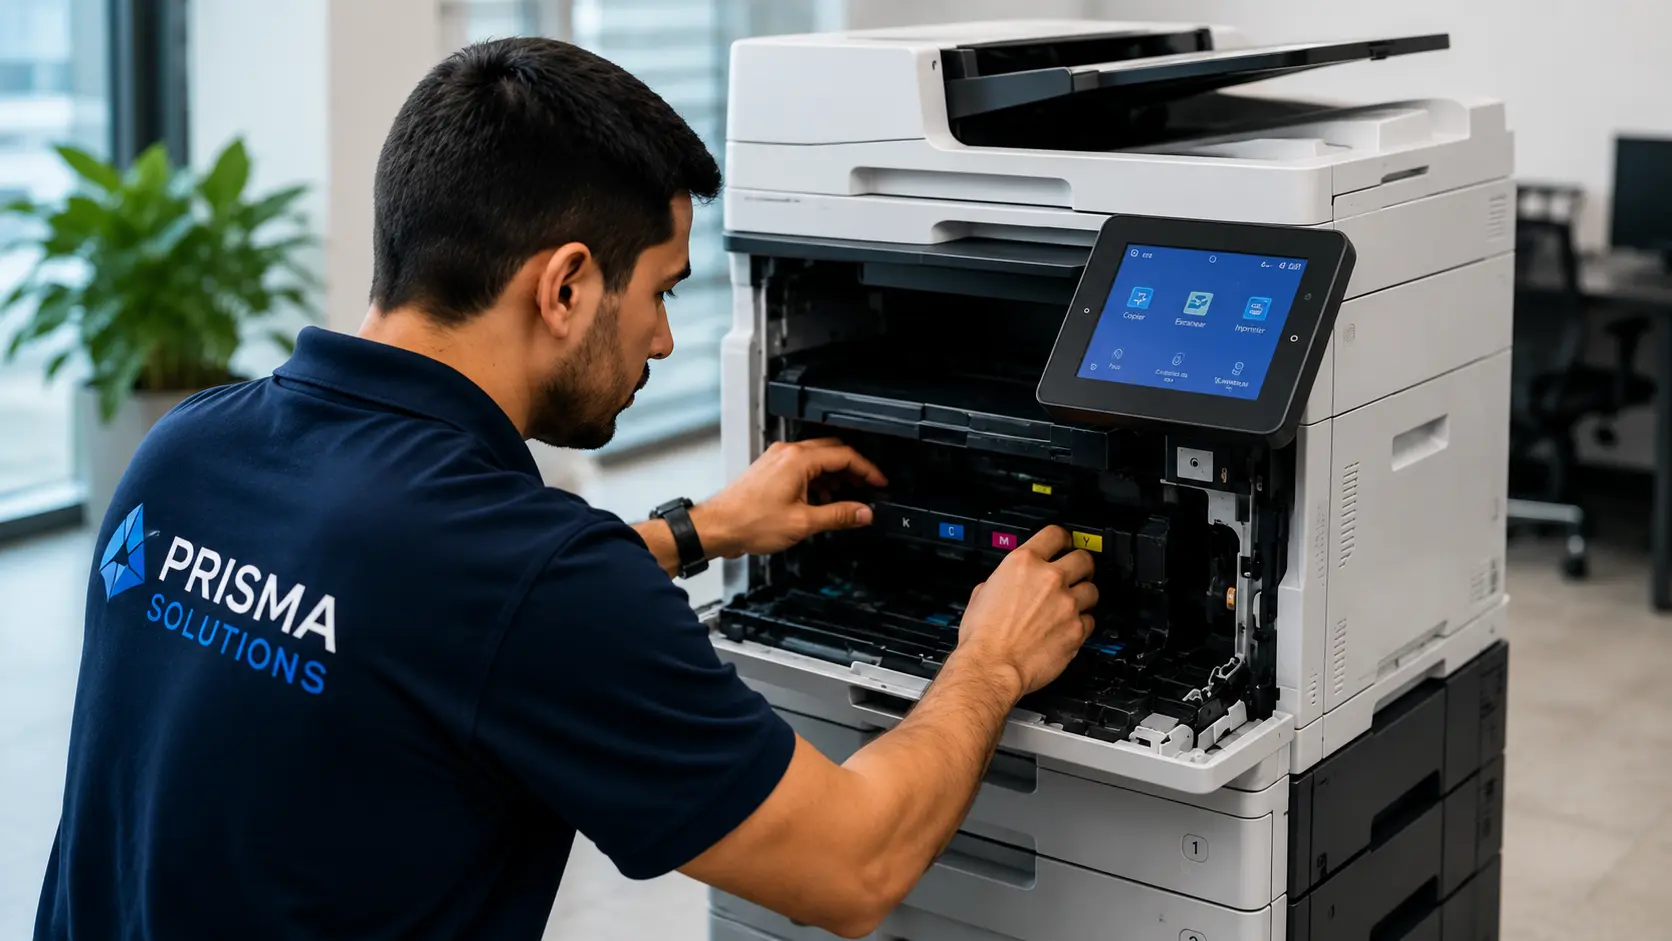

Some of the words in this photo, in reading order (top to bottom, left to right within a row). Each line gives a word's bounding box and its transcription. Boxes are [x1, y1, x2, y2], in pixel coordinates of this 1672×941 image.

[902, 517, 910, 528] K
[948, 526, 955, 536] C
[999, 535, 1010, 547] M
[1082, 535, 1091, 547] Y
[158, 535, 337, 654] PRISMA
[146, 592, 327, 695] SOLUTIONS
[1192, 840, 1198, 855] 1
